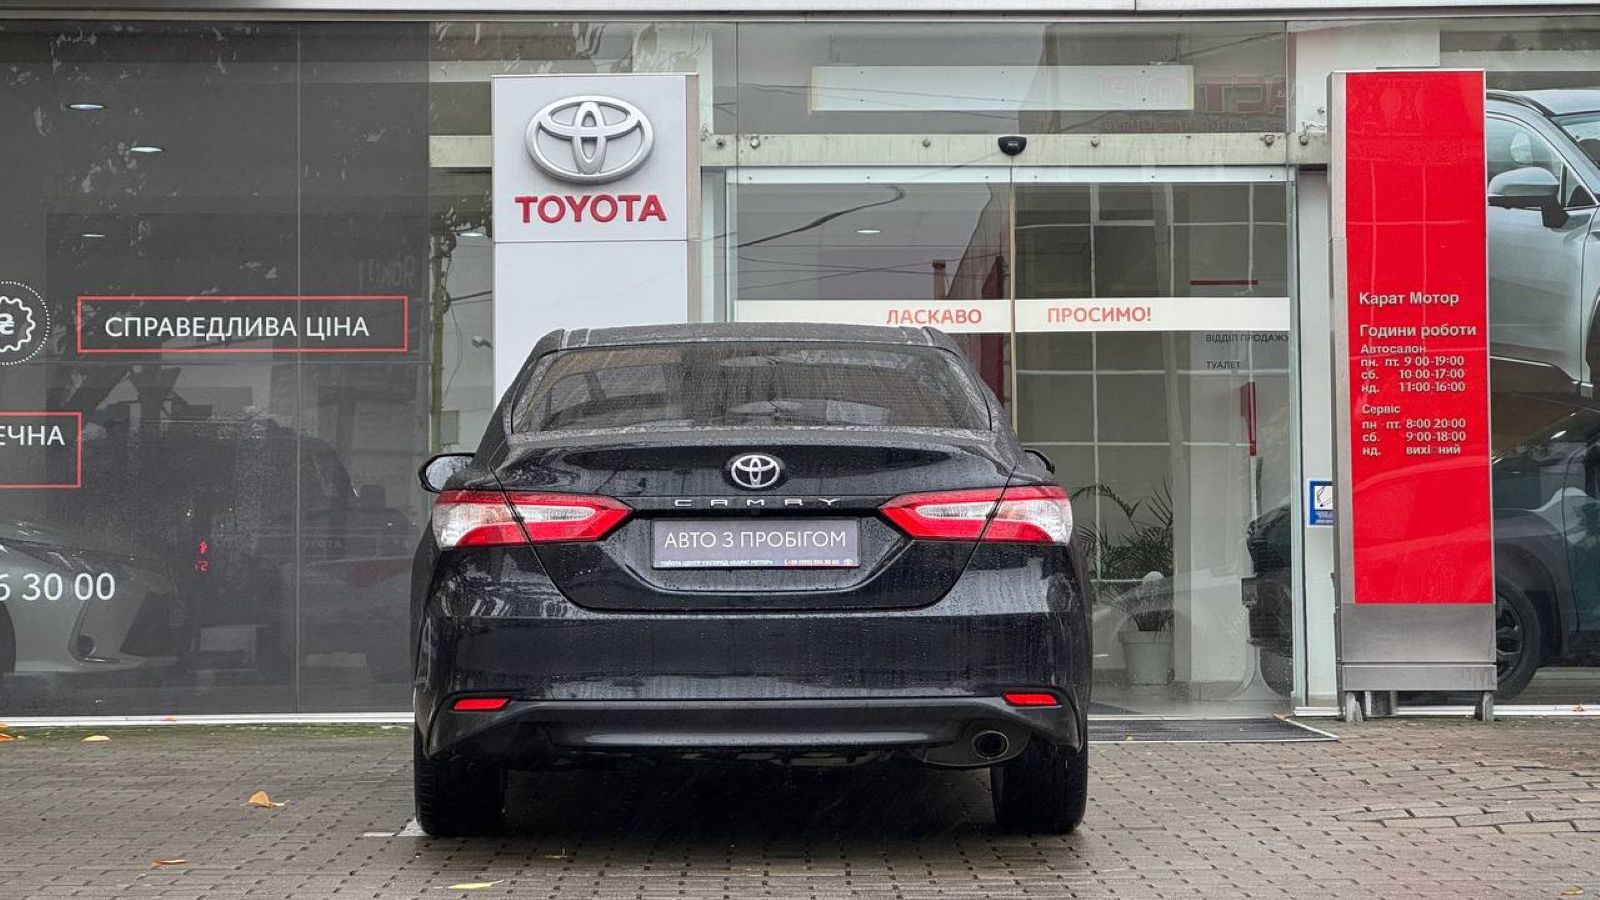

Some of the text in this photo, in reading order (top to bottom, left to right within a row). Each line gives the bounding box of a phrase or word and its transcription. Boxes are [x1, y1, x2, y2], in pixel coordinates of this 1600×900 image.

[514, 195, 667, 223] TOYOTA
[1360, 291, 1460, 307] Карат Мотор
[886, 306, 1152, 325] ЛАСКАВО ПРОСИМО!
[105, 316, 370, 341] СПРАВЕДЛИВА ЦІНА
[1360, 323, 1477, 339] Години роботи
[1360, 344, 1427, 354] Автосалон
[1361, 370, 1379, 380] сб.
[1361, 404, 1401, 416] Сервіс
[1363, 432, 1380, 442] сб.
[674, 498, 840, 507] CAMRY
[664, 531, 717, 549] АВТО
[740, 530, 847, 548] ПРОБІГОМ
[22, 573, 63, 601] 30
[74, 572, 116, 601] 00
